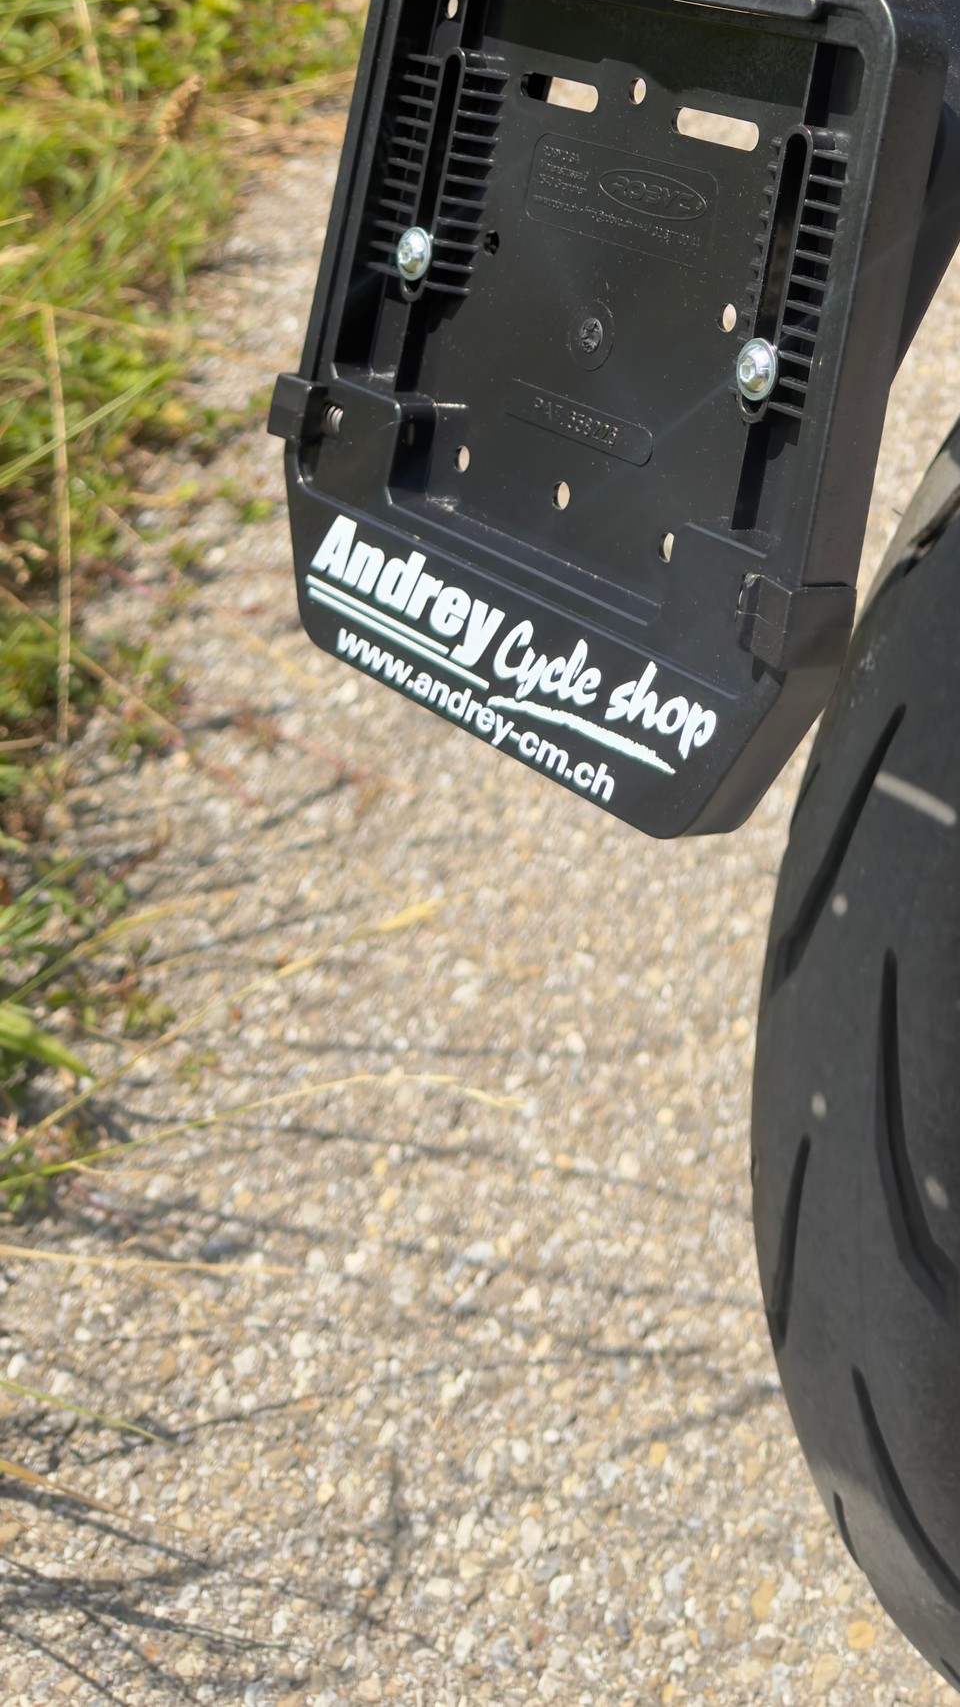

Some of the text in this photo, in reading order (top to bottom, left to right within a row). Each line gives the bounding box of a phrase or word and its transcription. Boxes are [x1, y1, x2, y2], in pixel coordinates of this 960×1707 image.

[310, 514, 717, 761] Andrey Cycle shop
[336, 627, 616, 803] www.andrey-cm.ch
